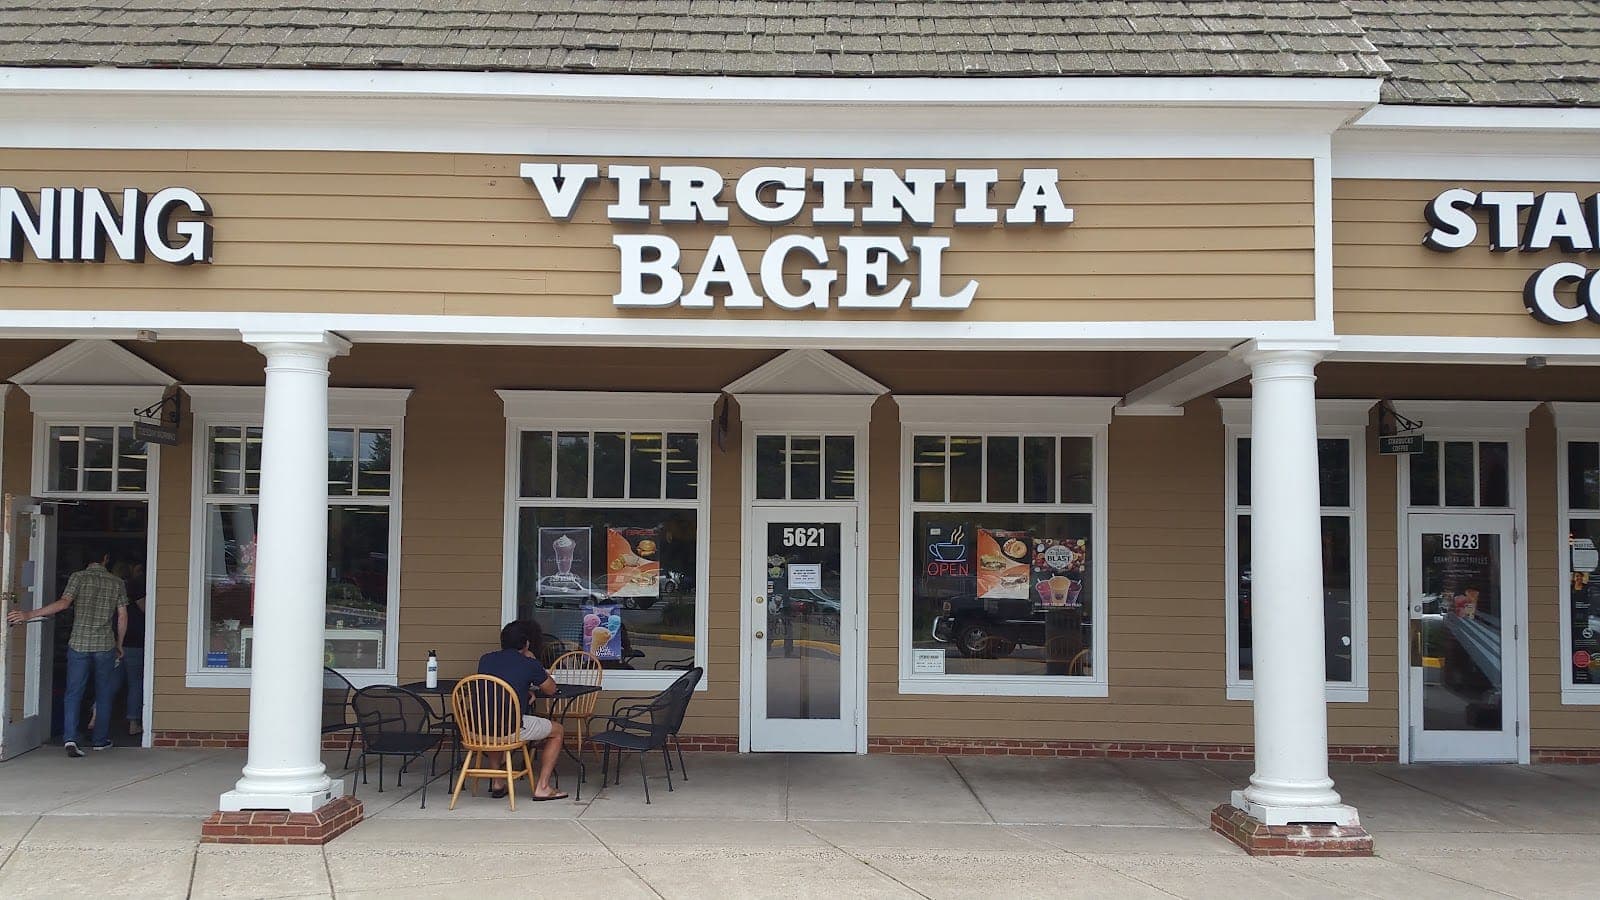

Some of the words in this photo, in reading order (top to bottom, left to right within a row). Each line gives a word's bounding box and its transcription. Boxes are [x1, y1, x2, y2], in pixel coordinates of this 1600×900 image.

[0, 187, 213, 263] NING
[520, 163, 1074, 225] VIRGINIA
[1422, 188, 1600, 252] STA
[611, 234, 979, 311] BAGEL
[783, 528, 825, 547] 5621
[1443, 534, 1478, 549] 5623
[928, 563, 968, 577] OPEN
